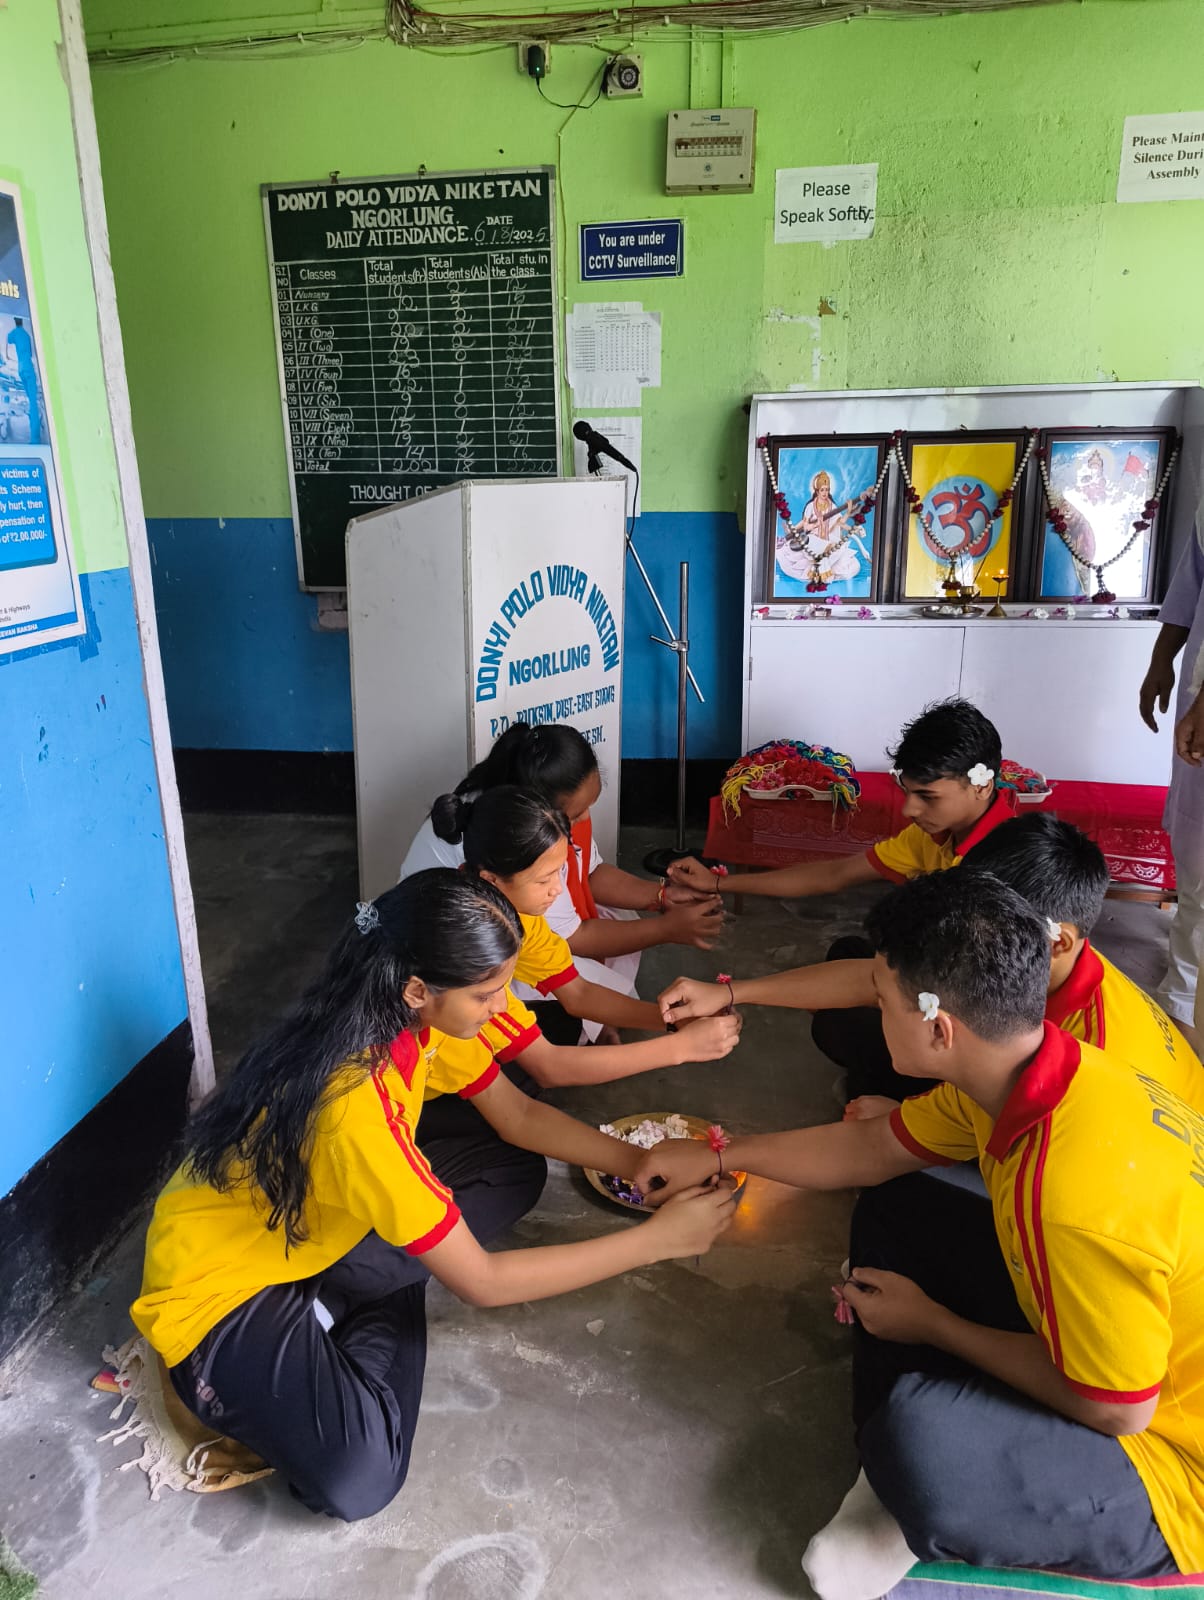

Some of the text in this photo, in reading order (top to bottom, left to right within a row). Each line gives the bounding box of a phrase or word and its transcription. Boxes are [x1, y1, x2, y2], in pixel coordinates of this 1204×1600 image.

[1132, 136, 1168, 147] Please
[1133, 152, 1174, 164] Silence
[1146, 166, 1200, 180] Assembly
[277, 179, 542, 212] DONYI POLO VIDYA NIKETAN
[802, 182, 851, 197] Please
[486, 216, 514, 226] DATE
[780, 206, 872, 227] Speak Softly
[326, 230, 362, 249] DAILY
[598, 231, 666, 248] You are under
[368, 260, 394, 271] Total
[428, 257, 453, 268] Total
[490, 253, 514, 265] Total
[588, 253, 676, 270] CCTV Surveillance
[299, 268, 337, 280] Classes
[491, 266, 507, 277] the
[310, 326, 335, 340] (One)
[309, 339, 334, 353] (Two)
[312, 352, 343, 366] (Three)
[300, 370, 313, 379] IV
[314, 366, 343, 380] (Four)
[302, 382, 311, 392] V
[312, 380, 337, 393] (Five)
[303, 396, 314, 405] VI
[316, 393, 341, 407] (Six)
[303, 409, 318, 419] VII
[320, 407, 353, 420] (Seven)
[304, 423, 321, 432] VIII
[322, 421, 354, 438] (Eight)
[305, 435, 318, 446] IX
[307, 448, 315, 458] X
[319, 446, 341, 460] (Ten)
[307, 460, 330, 471] Total
[1, 467, 40, 479] victims of
[11, 484, 41, 494] Scheme
[349, 485, 411, 500] THOUGHT
[8, 500, 26, 511] hurt,
[27, 500, 43, 509] then
[38, 514, 45, 524] of
[476, 564, 620, 702] DONYI POLO VIDYA NIKETAN
[508, 644, 591, 686] NGORLUNG
